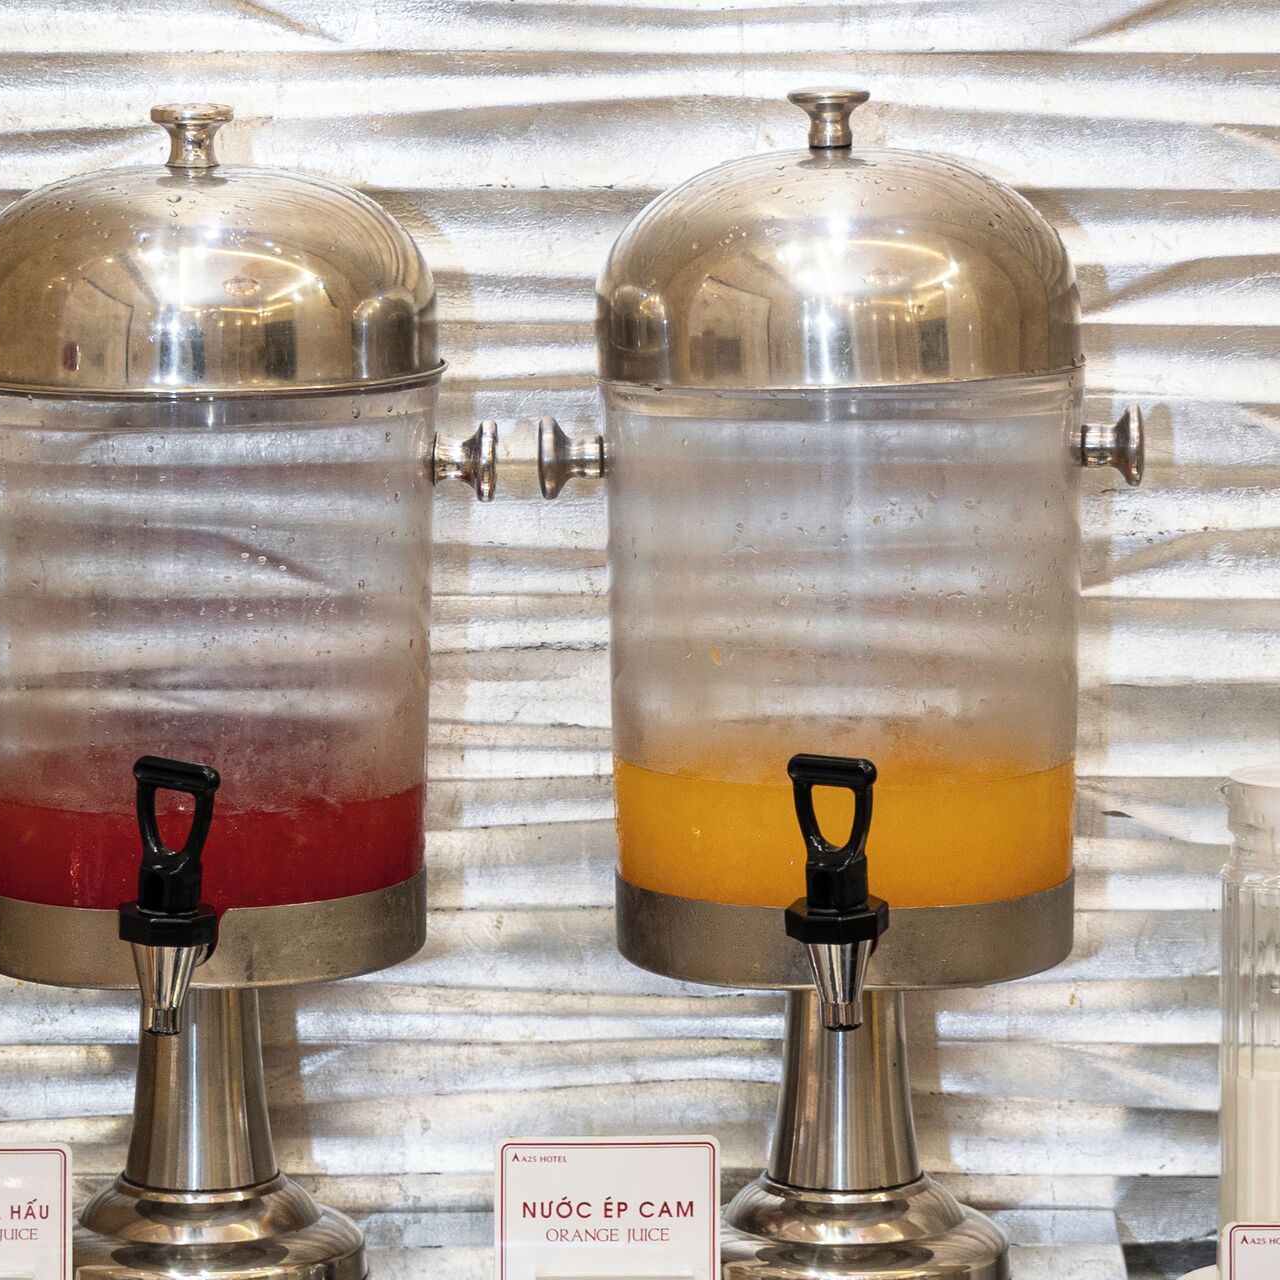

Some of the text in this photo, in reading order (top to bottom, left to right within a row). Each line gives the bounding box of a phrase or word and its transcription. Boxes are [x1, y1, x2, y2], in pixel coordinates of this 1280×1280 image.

[540, 1155, 567, 1163] HOTEL
[10, 1199, 50, 1220] HẤU
[522, 1196, 694, 1218] NƯỚC ÉP CAM
[0, 1227, 39, 1242] JUICE
[545, 1228, 670, 1244] ORANGE JUICE
[1250, 1237, 1266, 1245] A25
